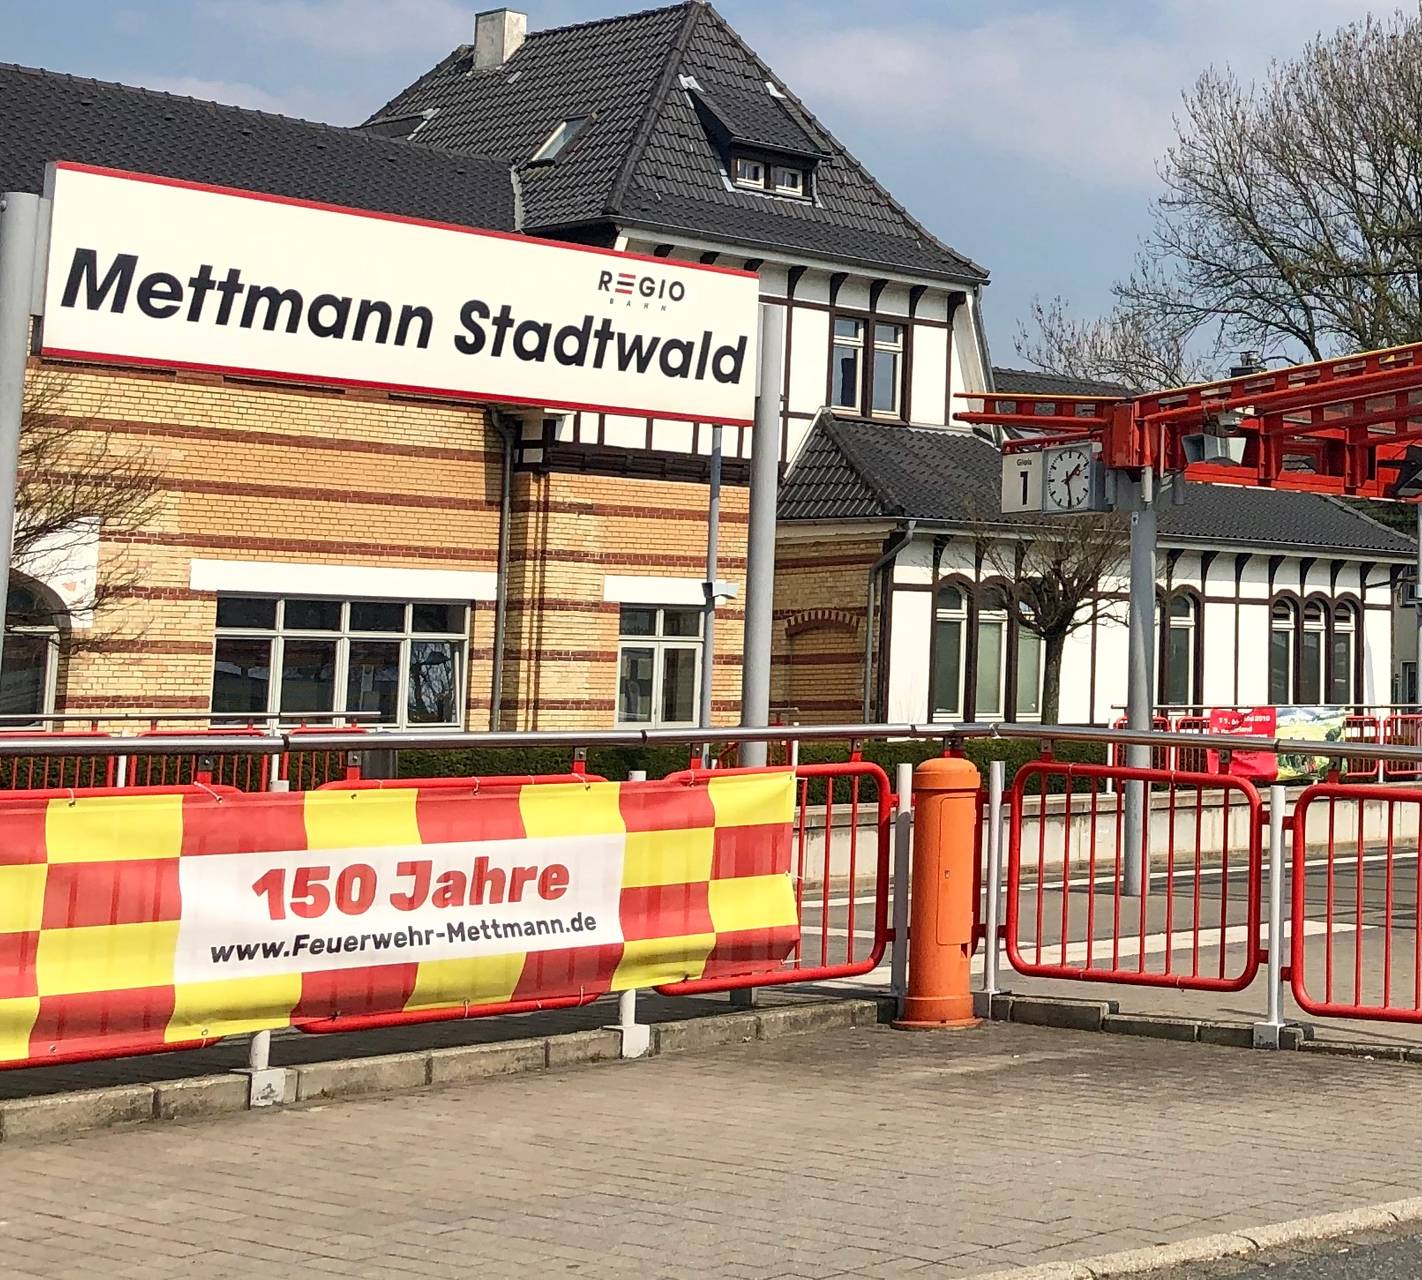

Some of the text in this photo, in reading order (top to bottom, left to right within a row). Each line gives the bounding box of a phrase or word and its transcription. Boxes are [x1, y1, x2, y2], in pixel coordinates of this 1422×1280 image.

[598, 270, 685, 301] REGIO
[60, 248, 748, 384] Mettmann Stadtwald
[1020, 471, 1029, 505] 1
[251, 855, 571, 921] 150 Jahre
[210, 911, 598, 965] www.Feuerwehr-Mettmann.de
